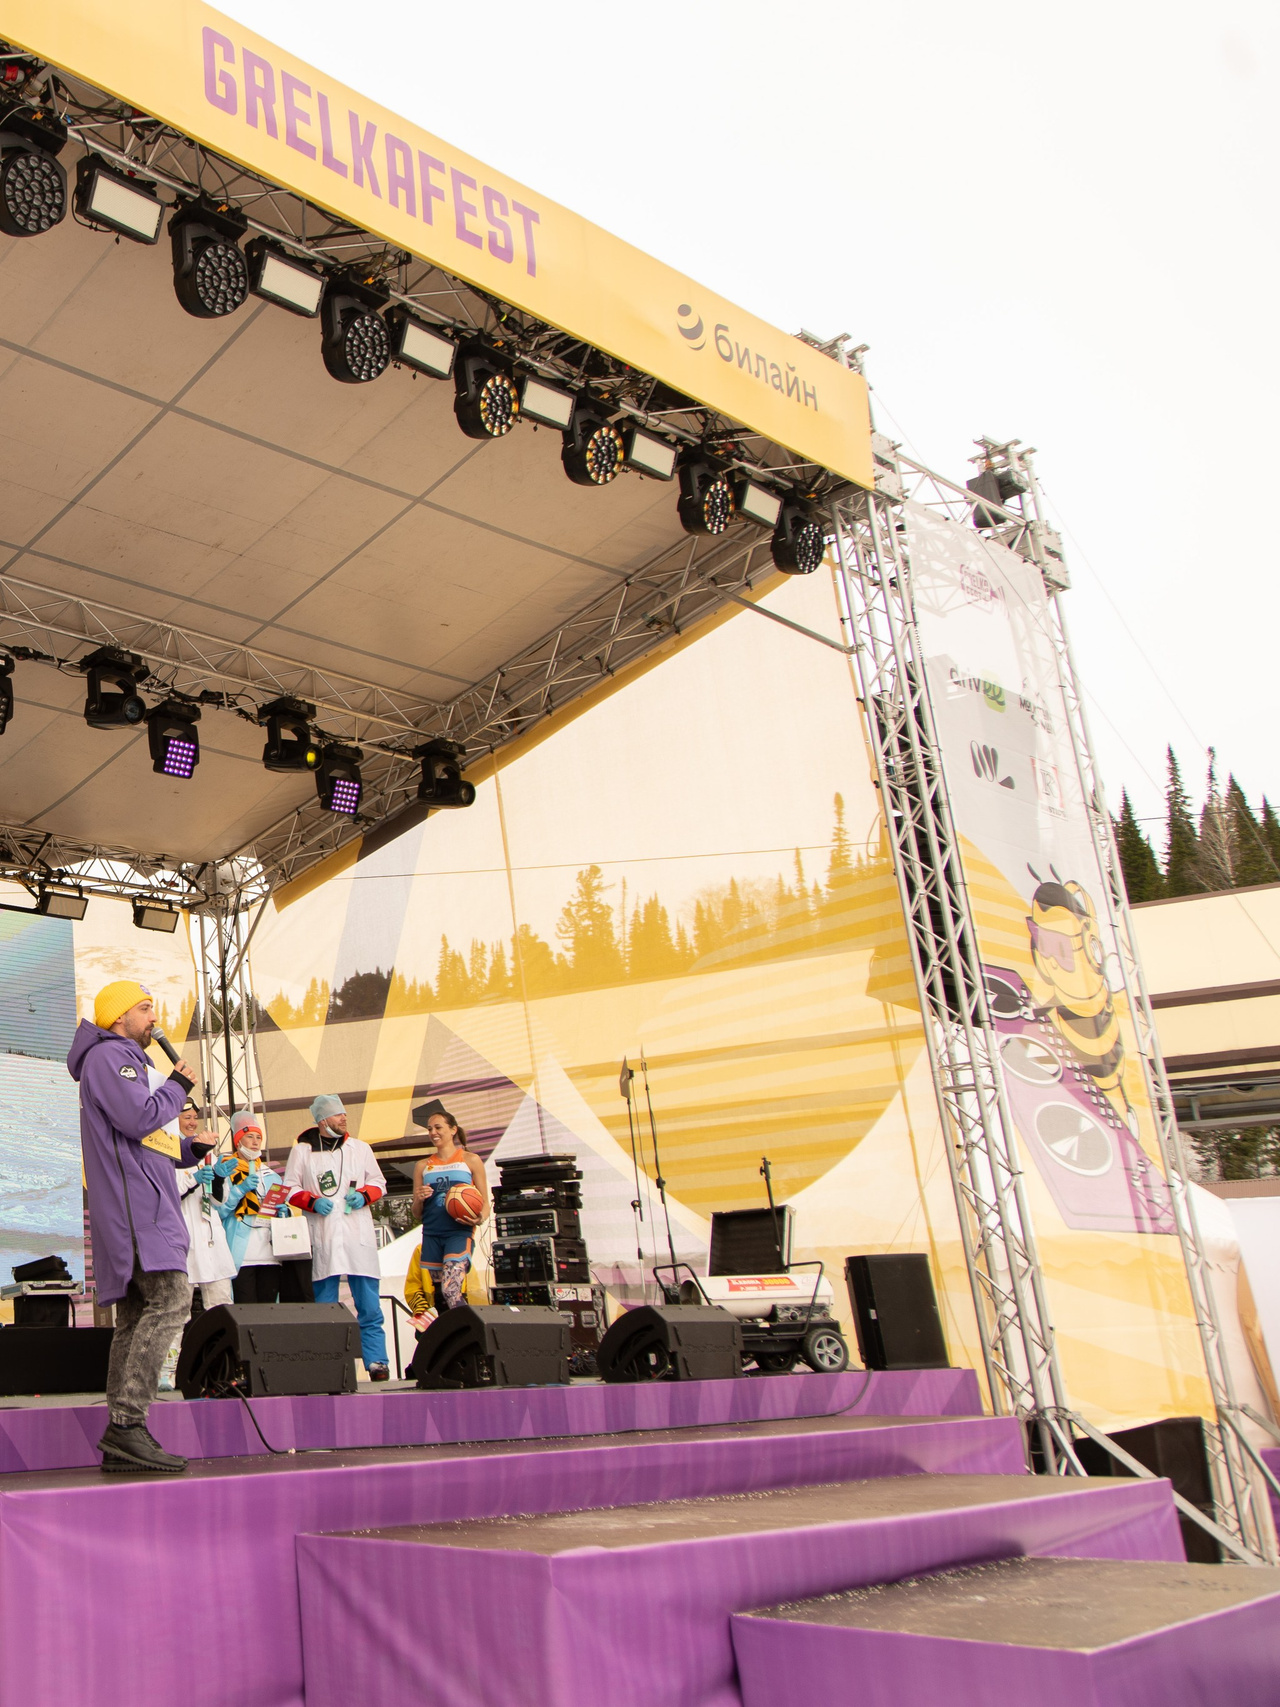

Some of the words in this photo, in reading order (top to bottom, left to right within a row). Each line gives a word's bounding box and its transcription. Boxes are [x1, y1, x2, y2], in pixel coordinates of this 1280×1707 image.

[201, 25, 540, 279] GRELKAFEST
[714, 323, 818, 412] билайн
[435, 1175, 451, 1192] 21
[262, 1350, 343, 1362] ProTone
